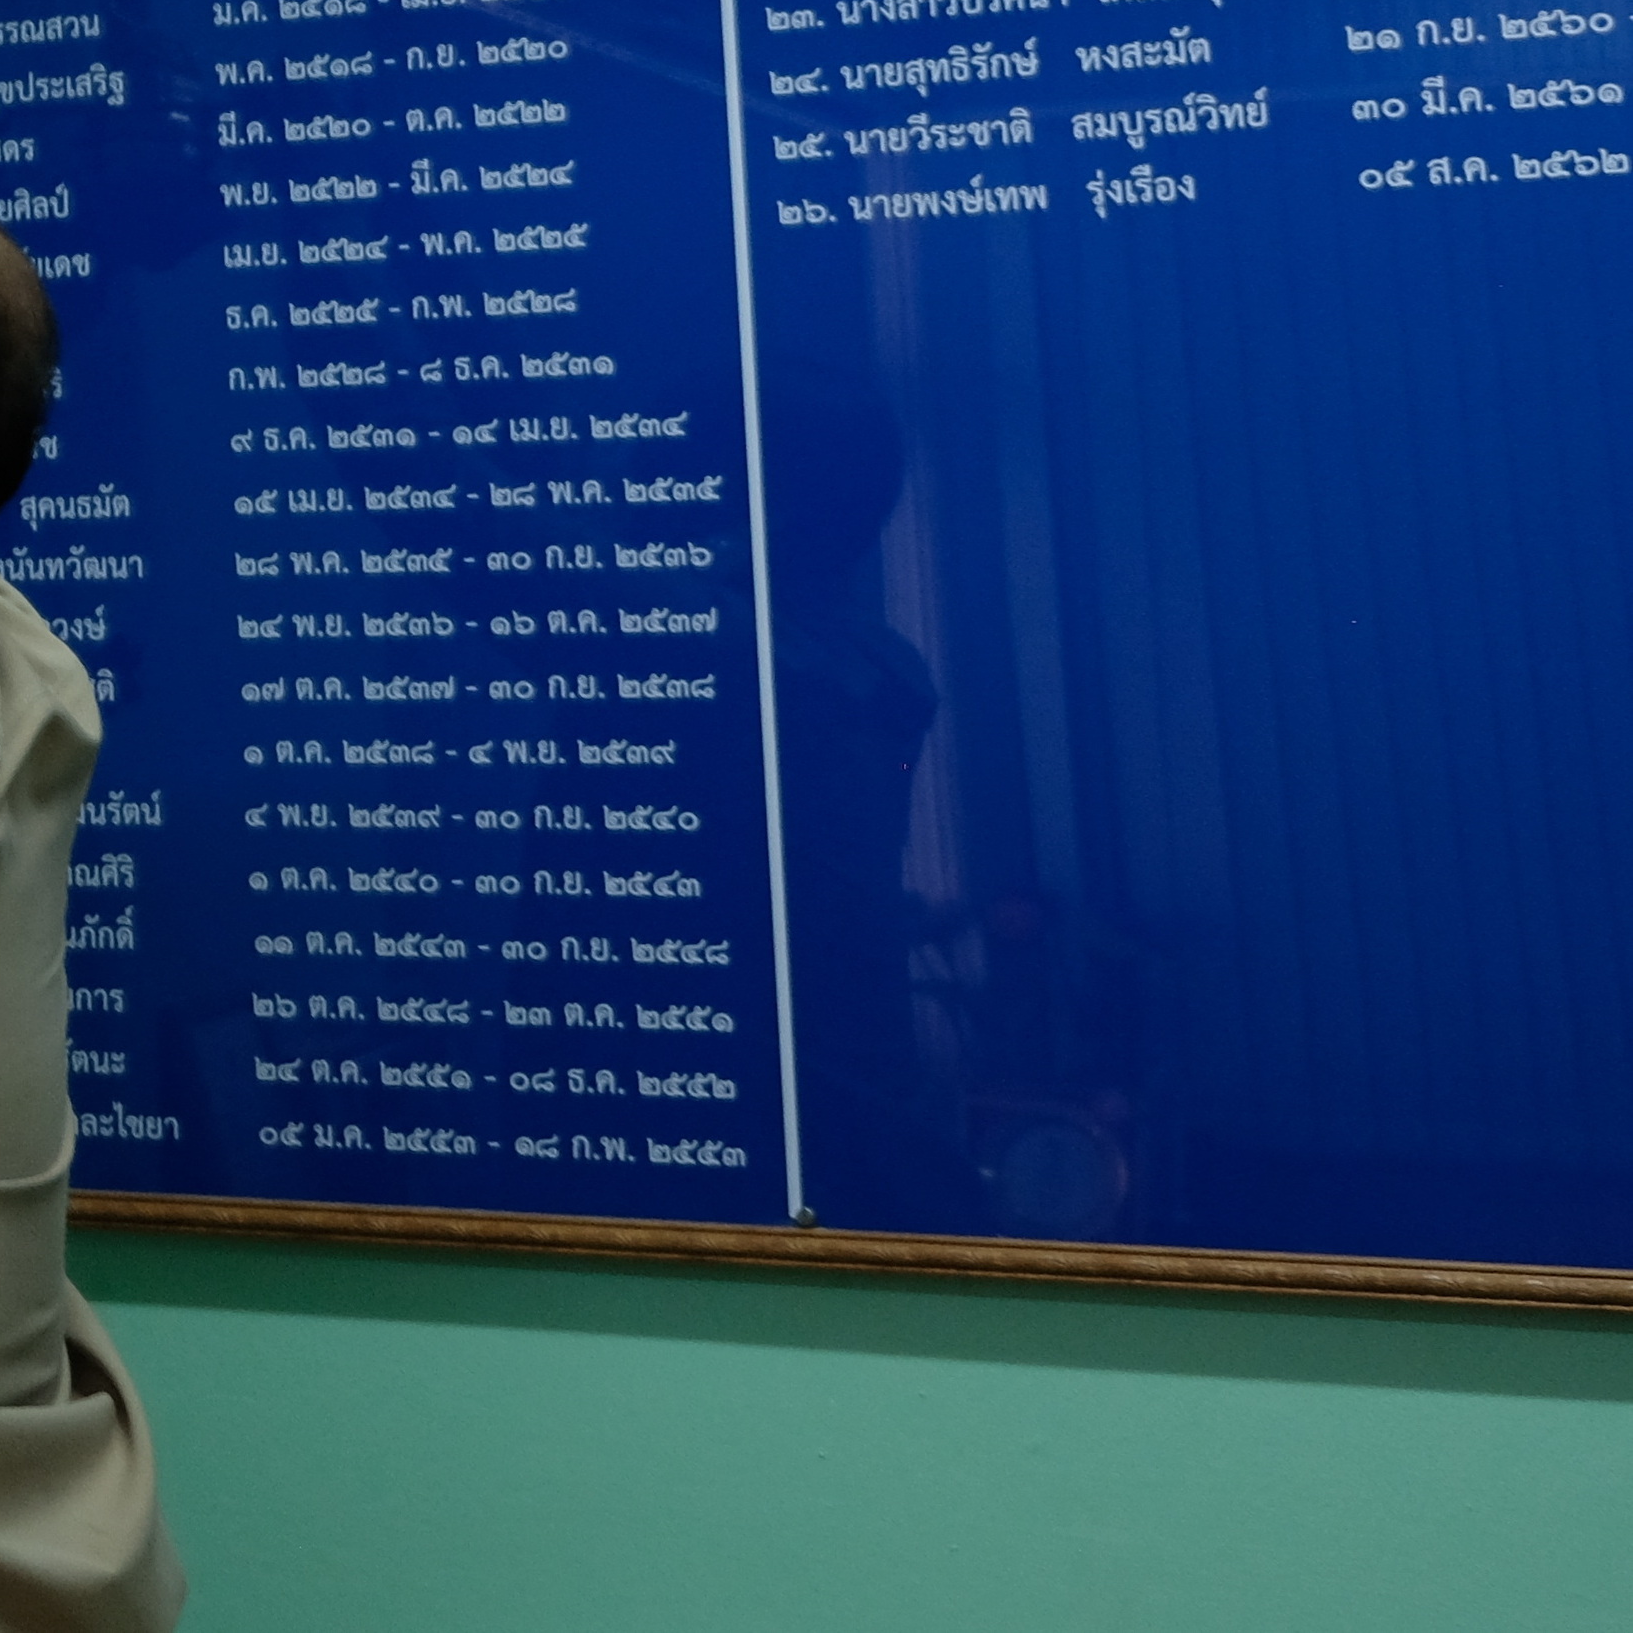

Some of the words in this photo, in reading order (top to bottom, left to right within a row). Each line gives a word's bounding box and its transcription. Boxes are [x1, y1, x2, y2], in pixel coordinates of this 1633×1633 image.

[212, 0, 268, 26] ม.ค.
[764, 6, 826, 33] ๒๓.
[1344, 25, 1404, 53] ๒๑
[1415, 16, 1487, 47] ก.ย.
[1497, 8, 1616, 41] ๒๕๖๐
[214, 59, 274, 87] พ.ค.
[283, 50, 374, 81] ๒๕๑๘
[405, 43, 466, 71] ก.ย.
[475, 36, 570, 66] ๒๕๒๐
[768, 67, 830, 97] ๒๔.
[839, 35, 1041, 98] นายสุทธิรักษ์
[1351, 97, 1408, 121] ๓๐
[1420, 74, 1496, 117] มี.ค.
[1506, 78, 1625, 110] ๒๕๖๑
[217, 110, 273, 147] มี.ค.
[282, 114, 372, 143] ๒๕๒๐
[405, 105, 463, 133] ต.ค.
[472, 98, 569, 128] ๒๕๒๒
[772, 131, 834, 161] ๒๕.
[842, 106, 1034, 156] นายวีระชาติ
[1070, 85, 1270, 150] สมบูรณ์วิทย์
[219, 181, 279, 208] พ.ย.
[288, 174, 379, 203] ๒๕๒๒
[409, 157, 469, 195] มี.ค.
[478, 159, 575, 191] ๒๕๒๔
[1358, 158, 1416, 191] ๐๕
[1426, 155, 1500, 186] ส.ค.
[1510, 147, 1632, 181] ๒๕๖๒
[776, 198, 838, 226] ๒๖.
[847, 173, 1050, 221] นายพงษ์เทพ
[1085, 163, 1197, 220] รุ่งเรือง
[223, 242, 288, 269] เม.ย.
[297, 234, 390, 265] ๒๕๒๔
[419, 230, 482, 257] พ.ค.
[491, 222, 590, 253] ๒๕๒๕
[225, 303, 278, 330] ธ.ค.
[288, 297, 381, 327] ๒๕๒๕
[411, 293, 473, 320] ก.พ.
[482, 287, 578, 317] ๒๕๒๘
[228, 365, 286, 391] ก.พ.
[296, 360, 387, 388] ๒๕๒๘
[419, 357, 443, 383] ๘
[453, 354, 510, 382] ธ.ค.
[519, 351, 617, 379] ๒๕๓๑
[230, 428, 254, 453] ๙
[262, 426, 317, 452] ธ.ค.
[326, 423, 418, 450] ๒๕๓๑
[452, 418, 500, 446] ๑๔
[508, 415, 579, 443] เม.ย.
[588, 410, 689, 440] ๒๕๓๔
[233, 488, 279, 516] ๑๕
[287, 487, 354, 514] เม.ย.
[363, 483, 458, 511] ๒๕๓๔
[488, 481, 537, 508] ๒๘
[546, 479, 613, 505] พ.ค.
[622, 474, 724, 503] ๒๕๓๕
[234, 552, 280, 577] ๒๘
[288, 550, 350, 576] พ.ค.
[360, 547, 454, 574] ๒๕๓๕
[486, 551, 534, 572] ๓๐
[544, 544, 604, 570] ก.ย.
[613, 541, 714, 569] ๒๕๓๖
[236, 613, 284, 640] ๒๔
[291, 613, 352, 638] พ.ย.
[361, 611, 455, 638] ๒๕๓๖
[489, 609, 537, 636] ๑๖
[546, 608, 608, 634] ต.ค.
[617, 606, 719, 634] ๒๕๓๗
[240, 676, 286, 703] ๑๗
[295, 676, 352, 701] ต.ค.
[361, 675, 457, 702] ๒๕๓๗
[488, 679, 536, 700] ๓๐
[547, 674, 606, 700] ก.ย.
[616, 672, 717, 700] ๒๕๓๘
[254, 934, 294, 955] ๑๑
[305, 930, 363, 957] ต.ค.
[373, 931, 467, 959] ๒๕๔๓
[501, 940, 549, 961] ๓๐
[560, 936, 620, 963] ก.ย.
[629, 937, 731, 966] ๒๕๔๘
[254, 1056, 302, 1082] ๒๔
[311, 1058, 369, 1085] ต.ค.
[379, 1060, 473, 1090] ๒๕๕๑
[509, 1067, 556, 1093] ๐๘
[567, 1067, 626, 1095] ธ.ค.
[636, 1069, 738, 1100] ๒๕๕๒
[258, 1121, 305, 1147] ๐๕
[313, 1123, 372, 1150] ม.ค.
[382, 1125, 477, 1155] ๒๕๕๓
[514, 1134, 560, 1159] ๑๘
[571, 1134, 636, 1162] ก.พ.
[646, 1137, 747, 1168] ๒๕๕๓
